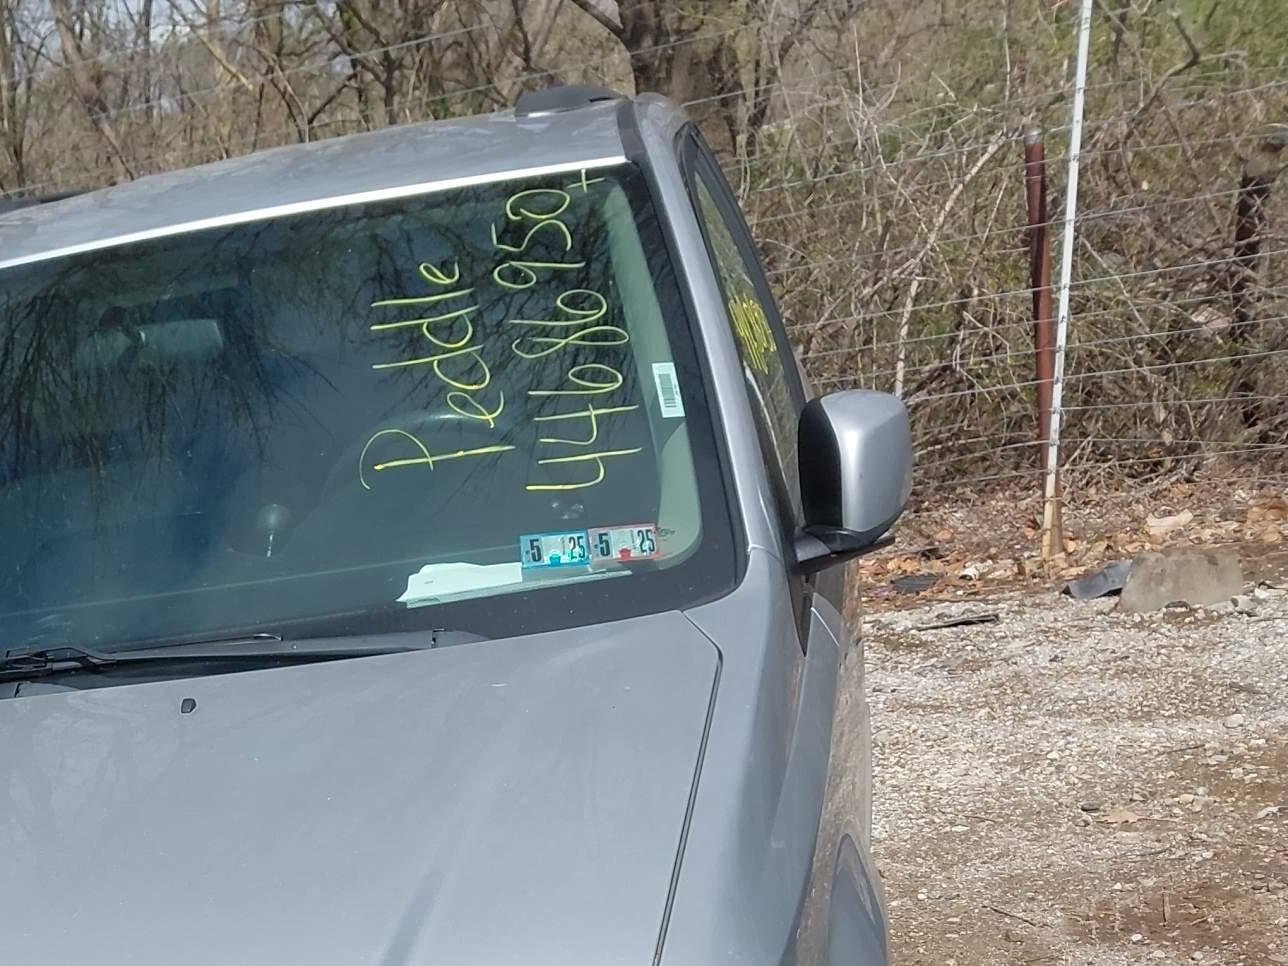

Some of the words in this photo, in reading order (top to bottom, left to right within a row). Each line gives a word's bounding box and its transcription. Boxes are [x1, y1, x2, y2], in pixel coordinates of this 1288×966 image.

[360, 256, 516, 489] Peddle
[529, 538, 543, 562] 5
[568, 535, 586, 560] 25
[598, 532, 611, 557] 5
[637, 528, 656, 553] 25
